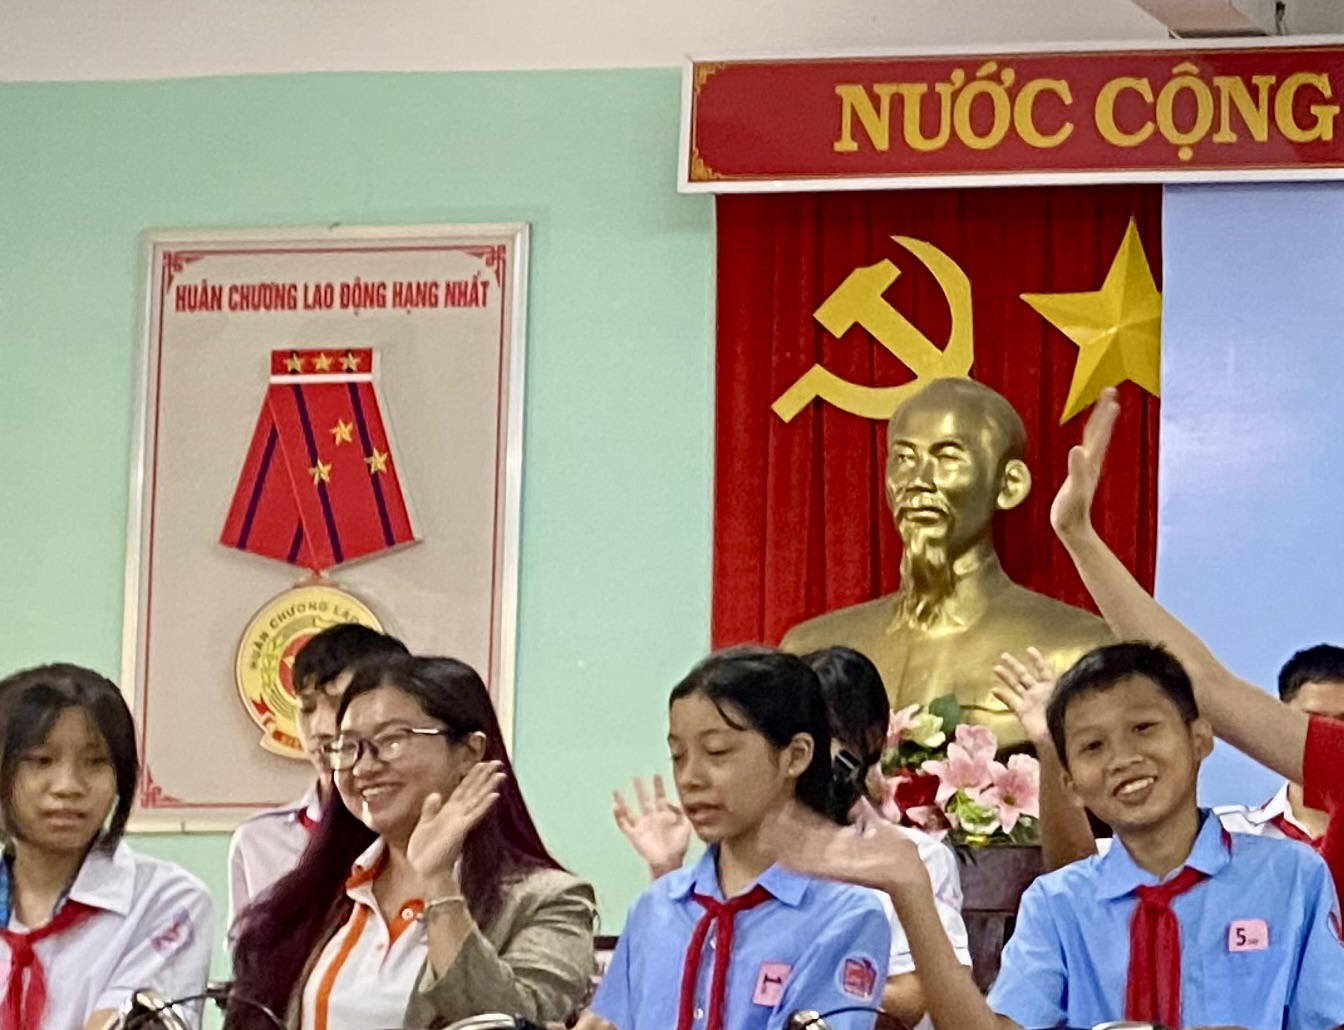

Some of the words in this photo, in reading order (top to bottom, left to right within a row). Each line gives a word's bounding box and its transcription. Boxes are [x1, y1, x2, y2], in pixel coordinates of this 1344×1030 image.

[834, 61, 1074, 152] NƯỚC
[1094, 62, 1340, 161] CỘNG
[175, 279, 223, 312] HUÂN
[227, 282, 298, 312] CHƯƠNG
[303, 283, 334, 310] LAO
[339, 276, 387, 316] ĐỘNG
[392, 280, 439, 315] HẠNG
[444, 270, 490, 309] NHẤT
[1235, 927, 1247, 946] 5
